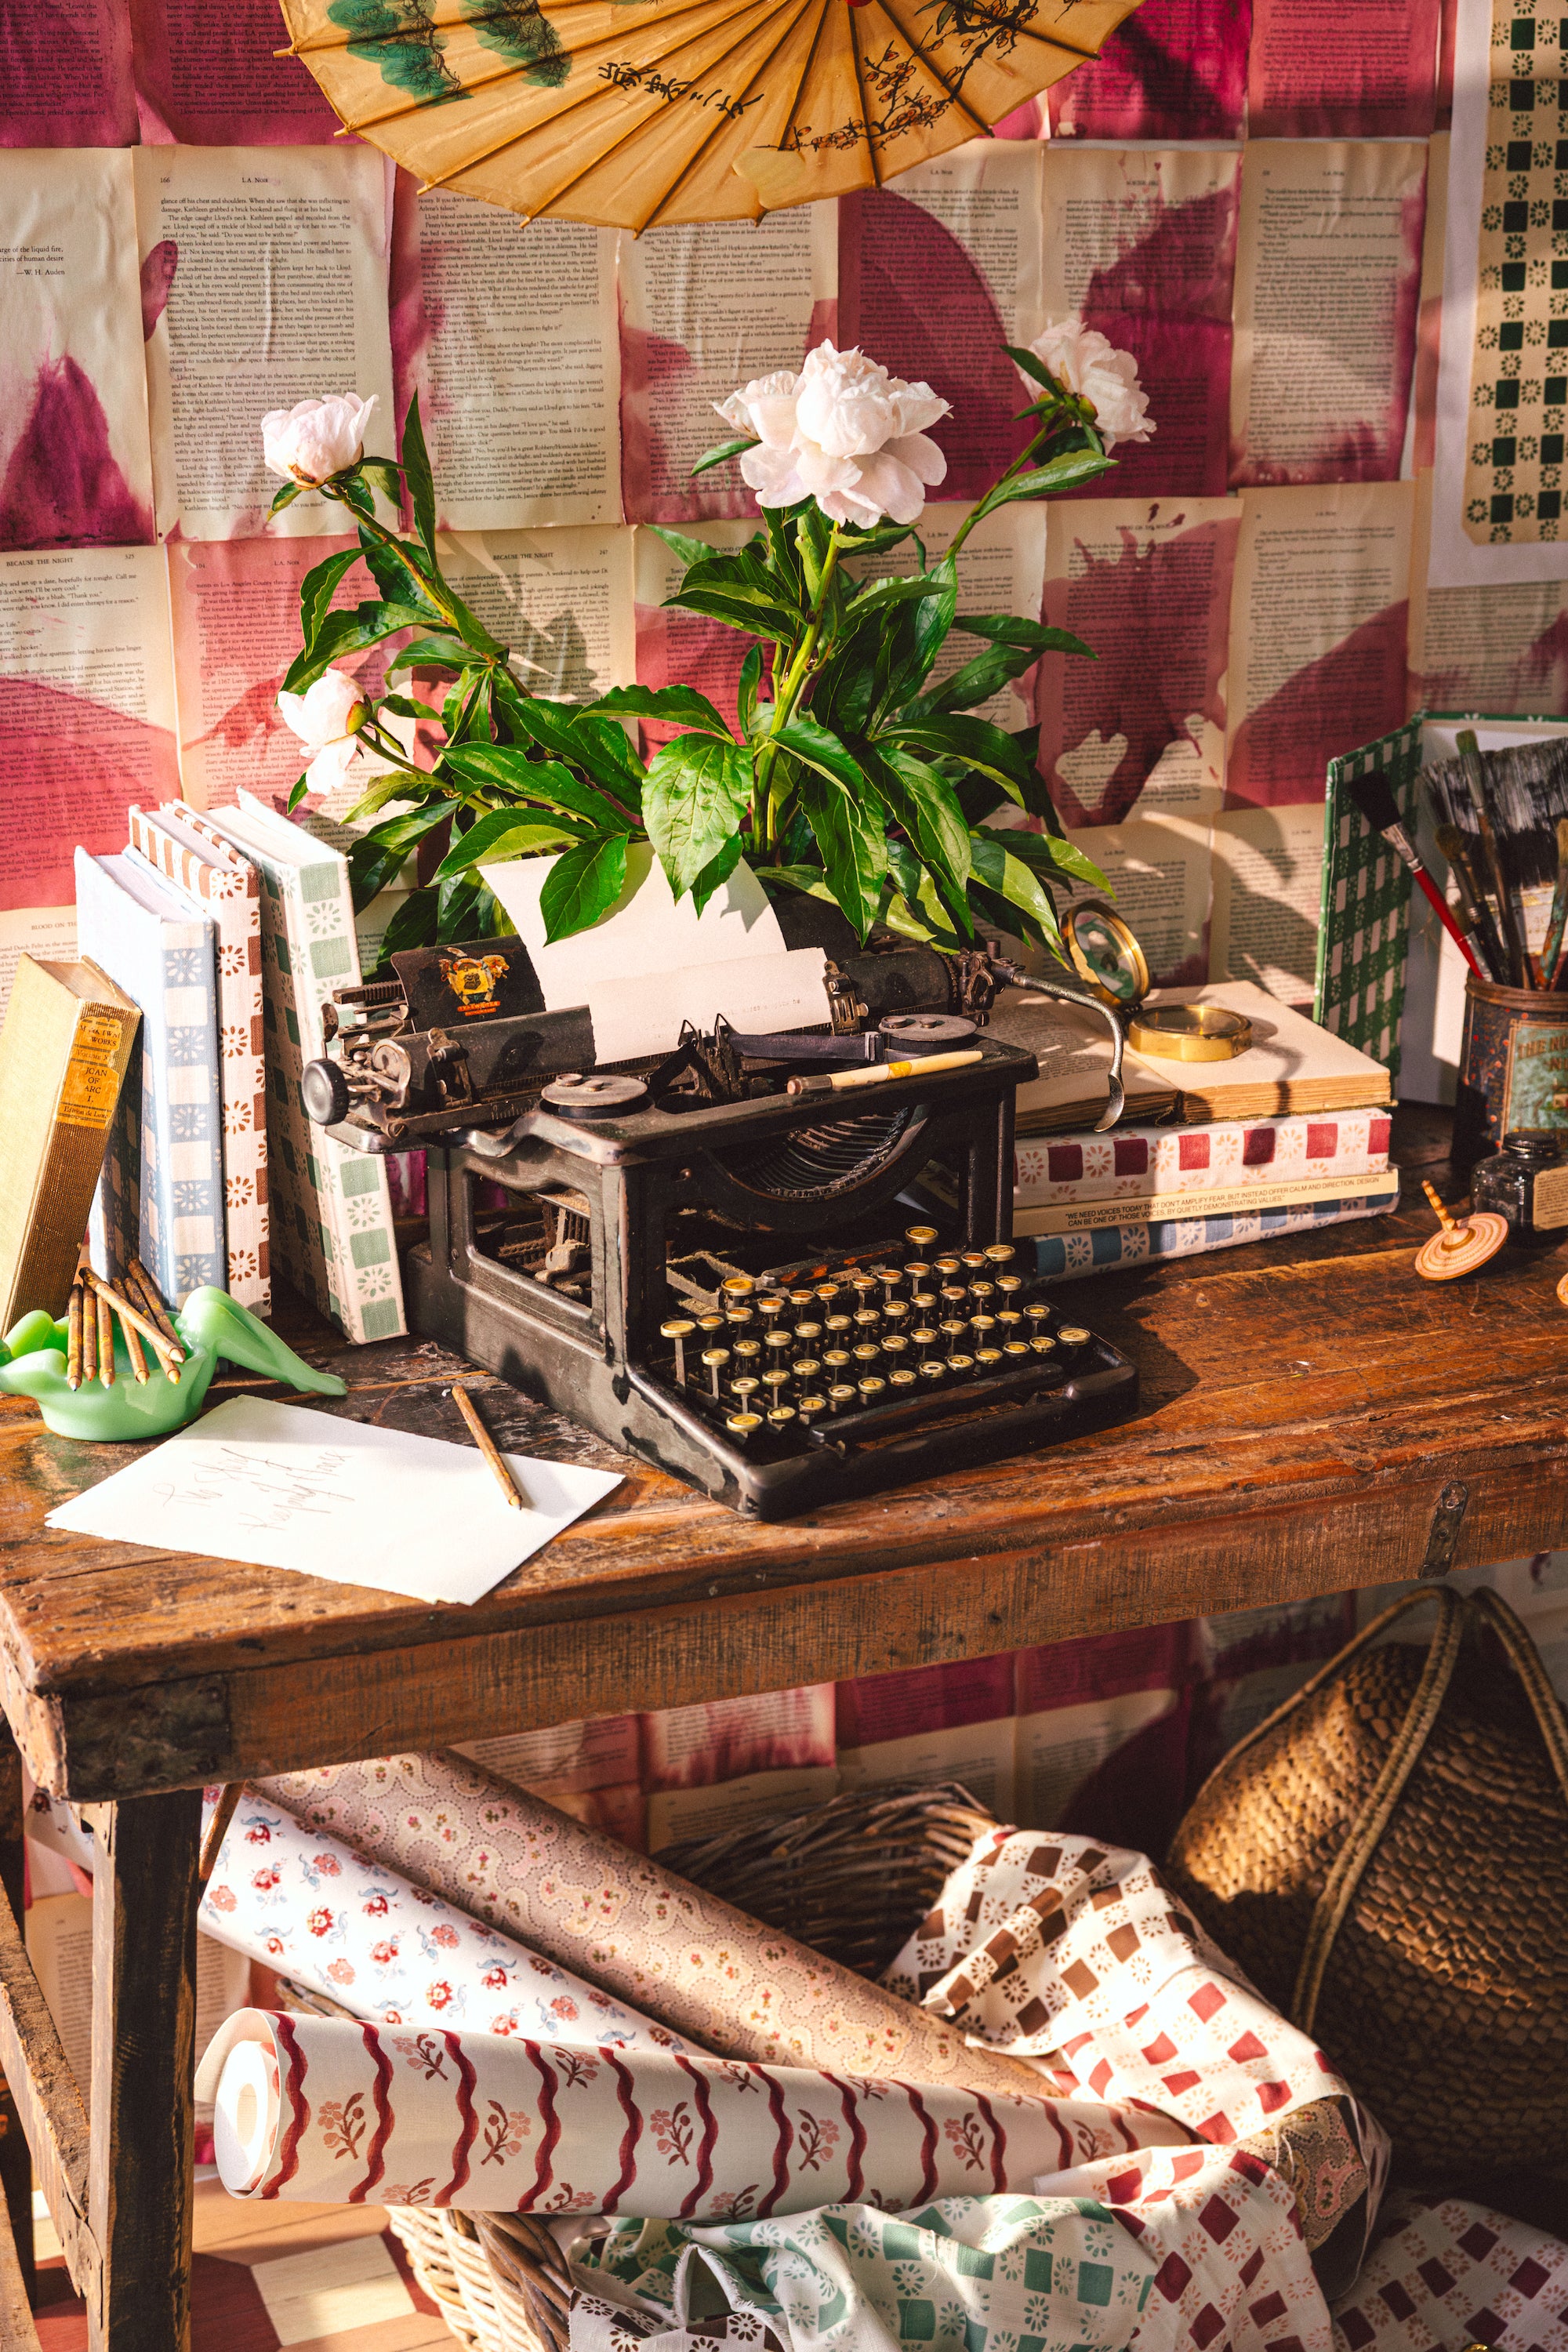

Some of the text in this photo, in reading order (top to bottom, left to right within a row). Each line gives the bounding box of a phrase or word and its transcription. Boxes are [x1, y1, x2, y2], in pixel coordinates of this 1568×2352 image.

[15, 604, 29, 612] right,
[85, 599, 105, 608] therapy
[91, 1036, 116, 1046] WORKS
[85, 1067, 108, 1076] JOAN
[85, 1085, 101, 1094] ARC
[64, 1106, 84, 1116] Edition
[1078, 1210, 1096, 1218] NEED
[1097, 1207, 1121, 1216] VOICES
[1122, 1204, 1142, 1213] TODAY
[1143, 1202, 1159, 1211] THAT
[1160, 1200, 1179, 1209] DON'T
[1181, 1197, 1207, 1206] AMPLIFY
[1209, 1195, 1226, 1204] FEAR,
[1241, 1189, 1267, 1199] INSTEAD
[1268, 1187, 1288, 1196] OFFER
[1289, 1185, 1307, 1193] CALM
[1308, 1183, 1321, 1191] AND
[1322, 1179, 1355, 1190] DIRECTION.
[1356, 1176, 1379, 1186] DESIGN
[1068, 1219, 1082, 1227] CAN
[1093, 1216, 1107, 1224] ONE
[1118, 1212, 1140, 1221] THOSE
[1141, 1209, 1164, 1219] VOICES,
[1176, 1205, 1201, 1214] QUIETLY
[1203, 1198, 1257, 1211] DEMONSTRATING
[1258, 1195, 1285, 1205] VALUES."
